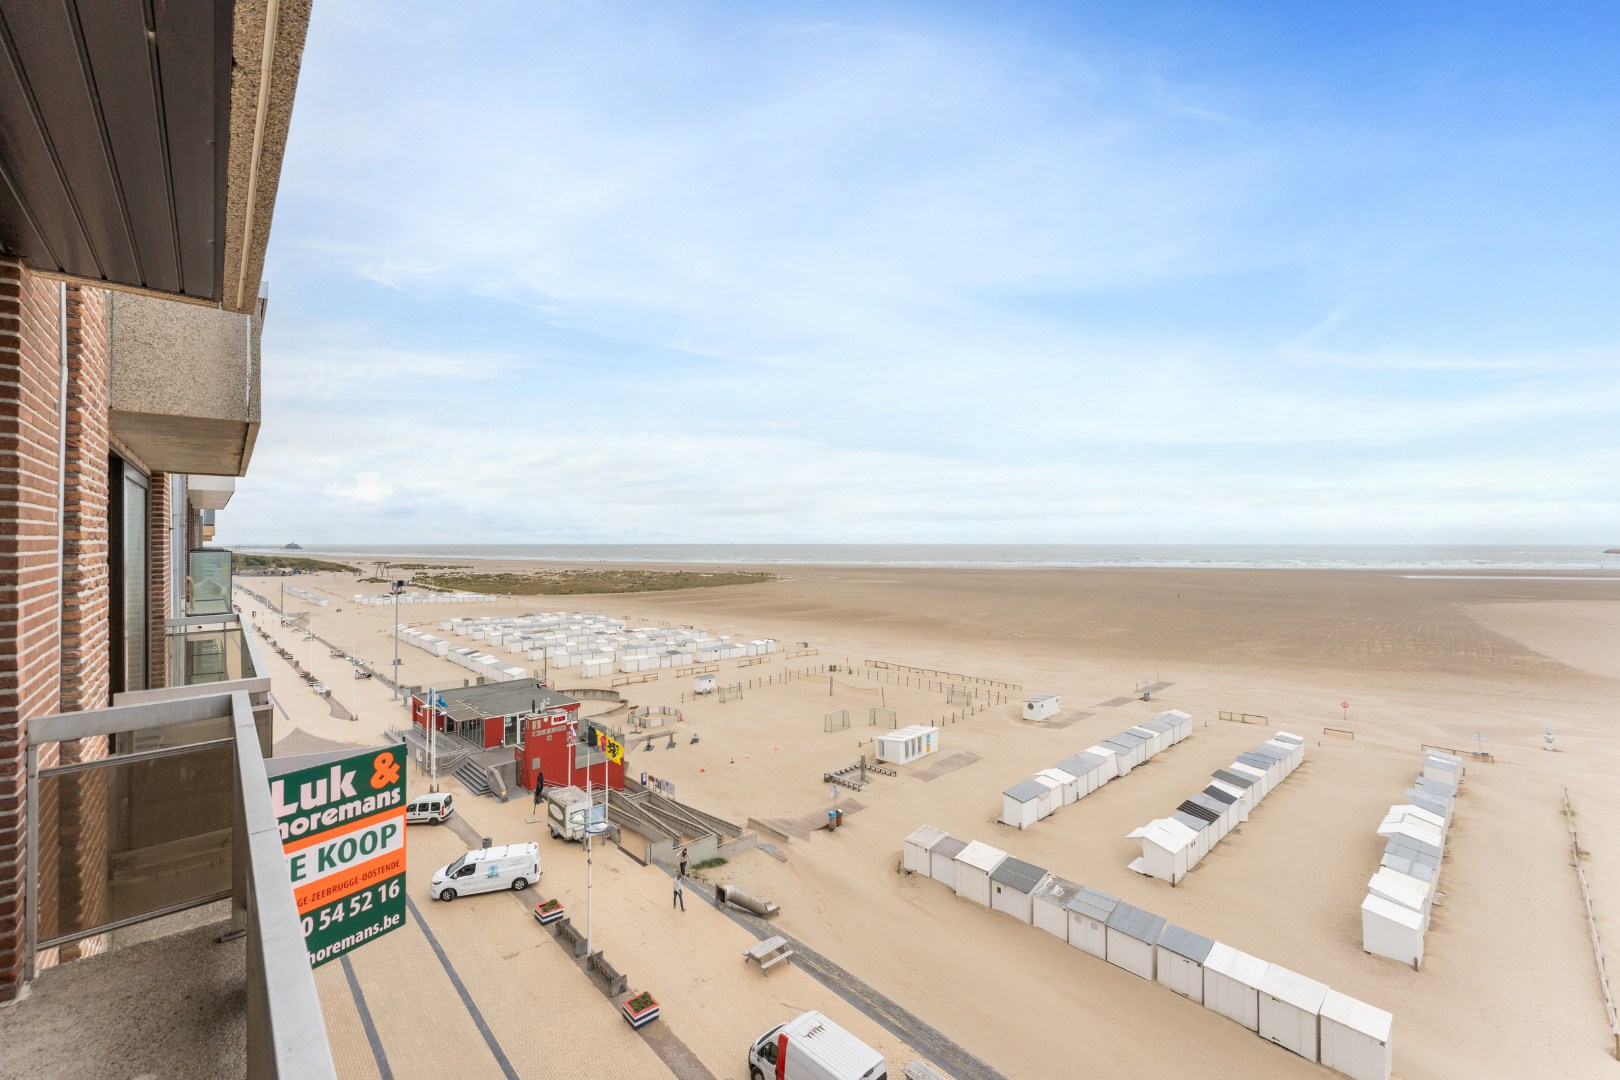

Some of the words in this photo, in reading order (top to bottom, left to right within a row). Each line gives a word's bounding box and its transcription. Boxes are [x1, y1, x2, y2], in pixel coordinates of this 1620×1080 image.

[271, 765, 357, 819] Luk
[370, 751, 400, 789] &
[318, 823, 397, 873] KOOP
[318, 903, 345, 931] 54
[349, 891, 373, 917] 52
[378, 879, 400, 903] 16
